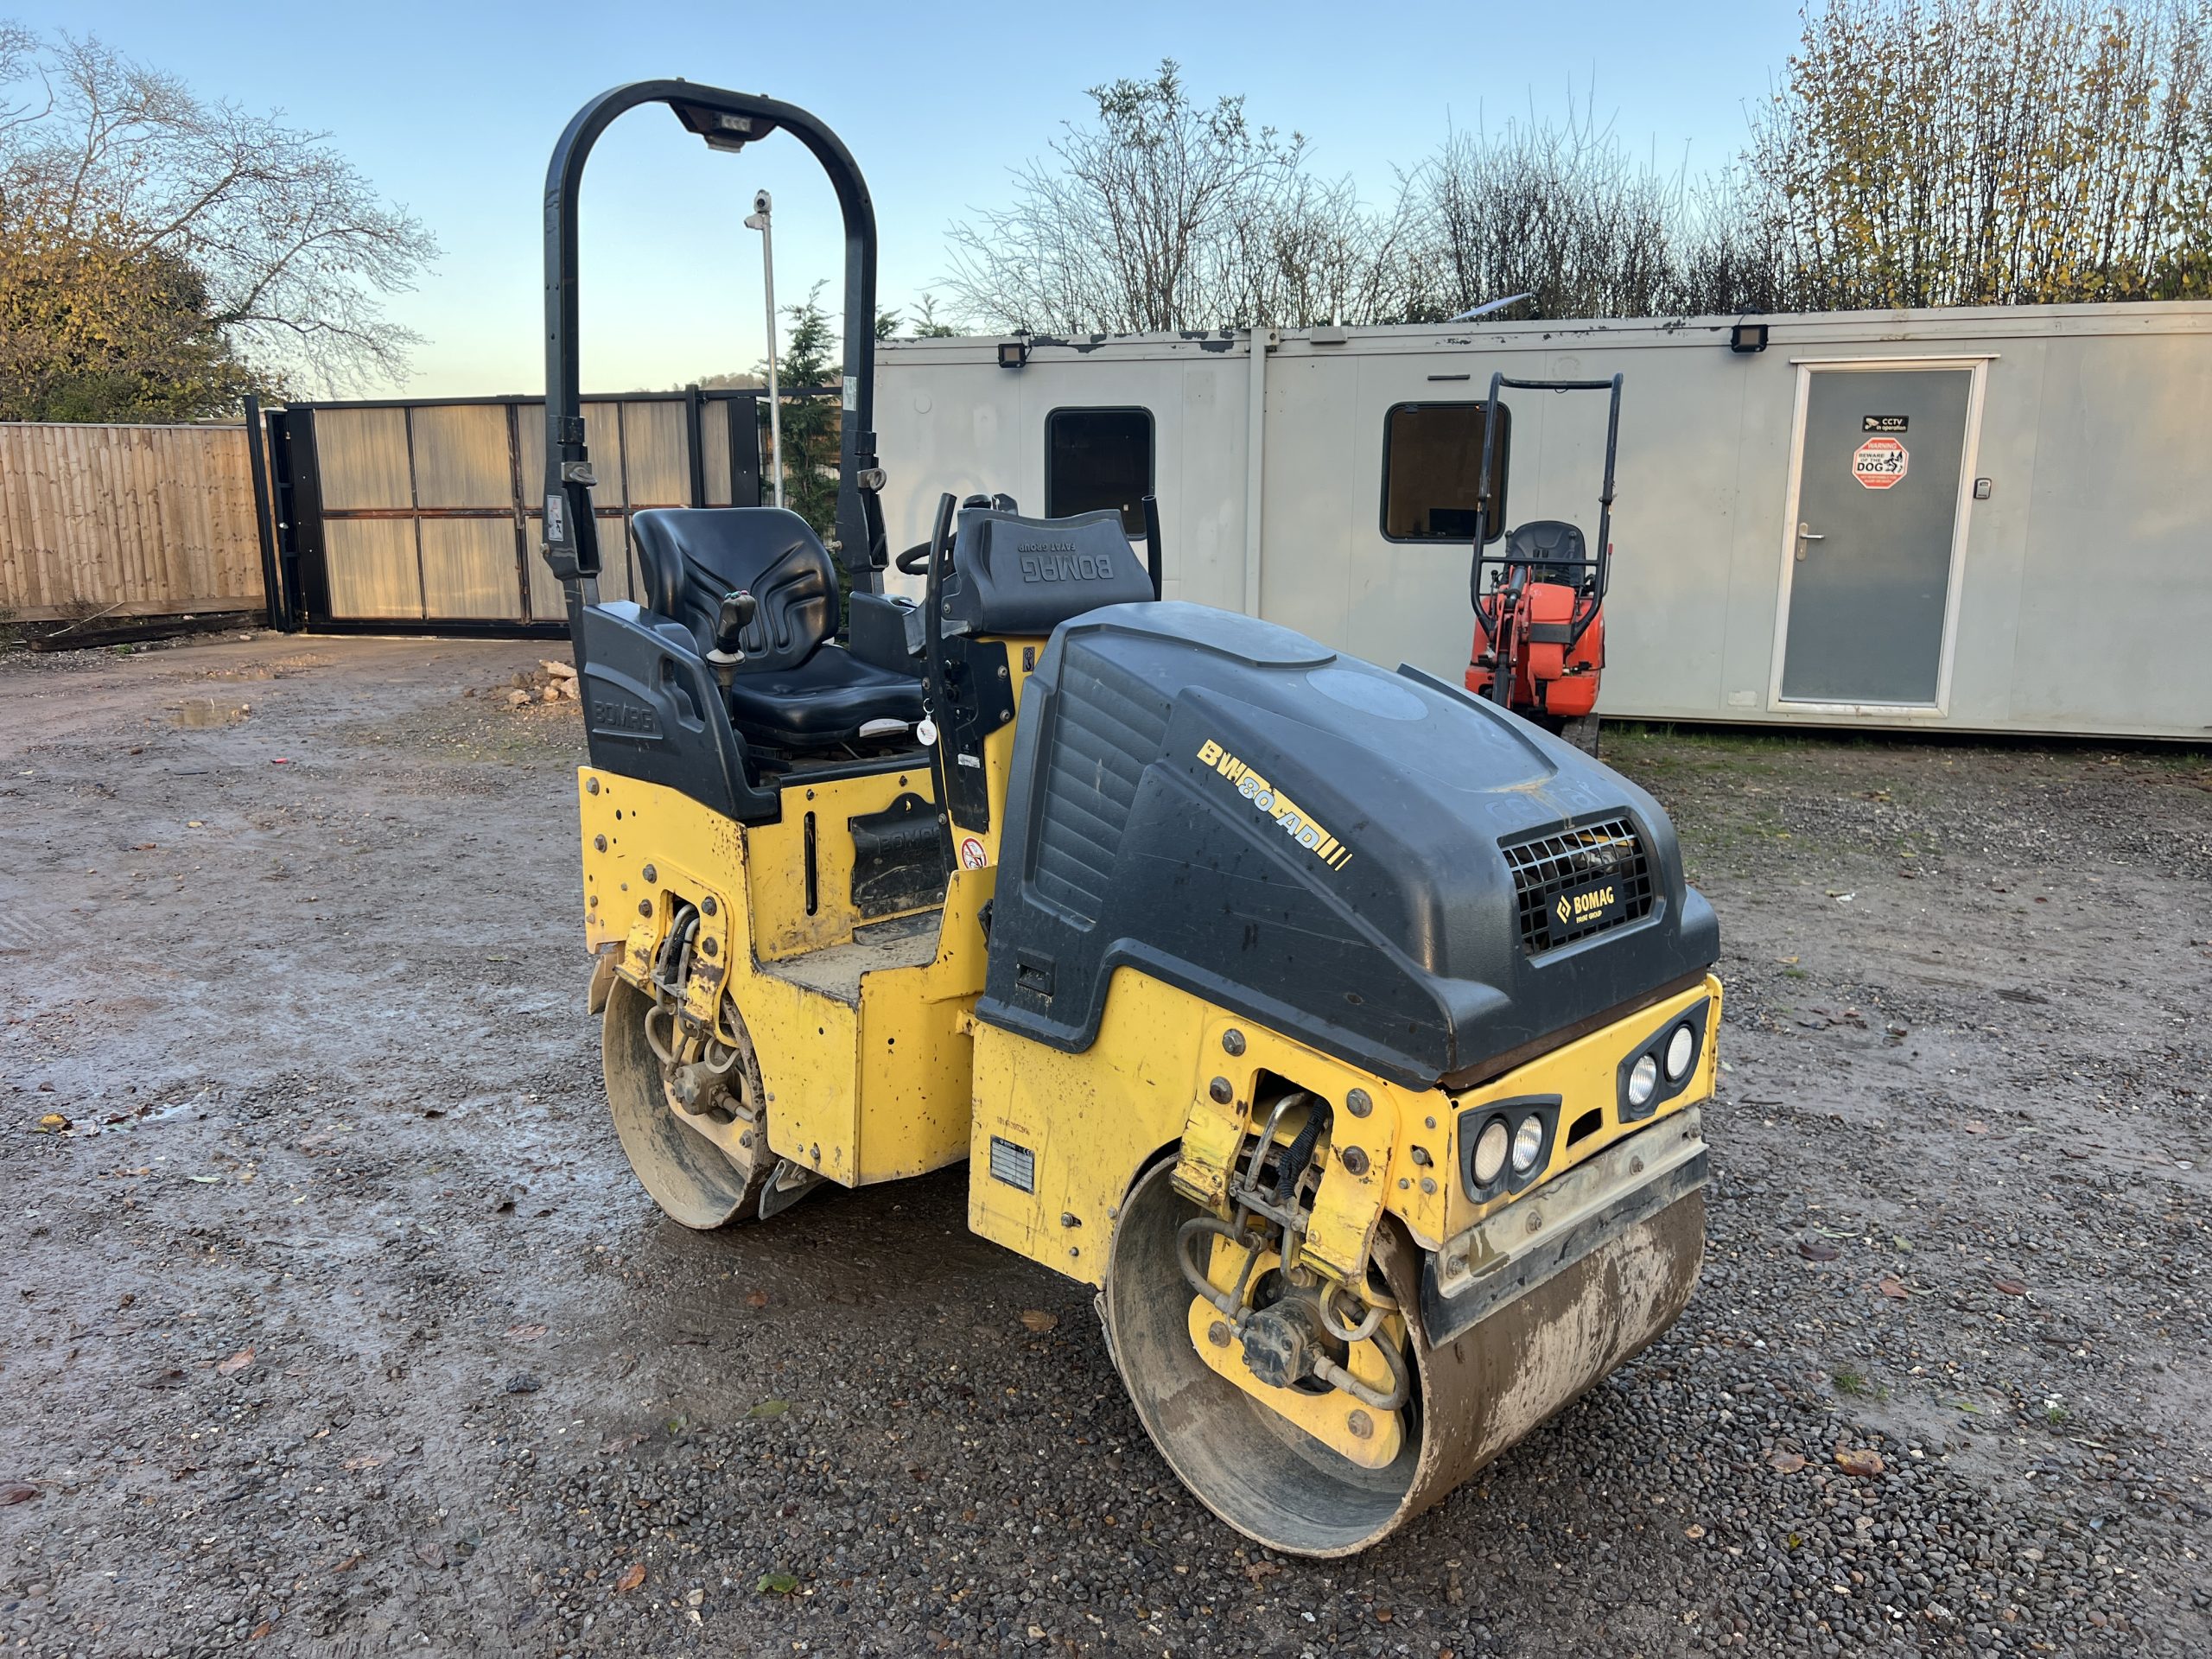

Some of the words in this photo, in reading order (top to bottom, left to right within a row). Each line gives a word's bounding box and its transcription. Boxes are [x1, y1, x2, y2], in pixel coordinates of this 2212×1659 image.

[1857, 462, 1884, 472] DOG
[1018, 543, 1047, 553] GROUP
[1050, 543, 1077, 552] FAYAT
[1020, 554, 1115, 583] BOMAG
[594, 701, 652, 732] BOMAG
[1573, 887, 1614, 914] BOMAG
